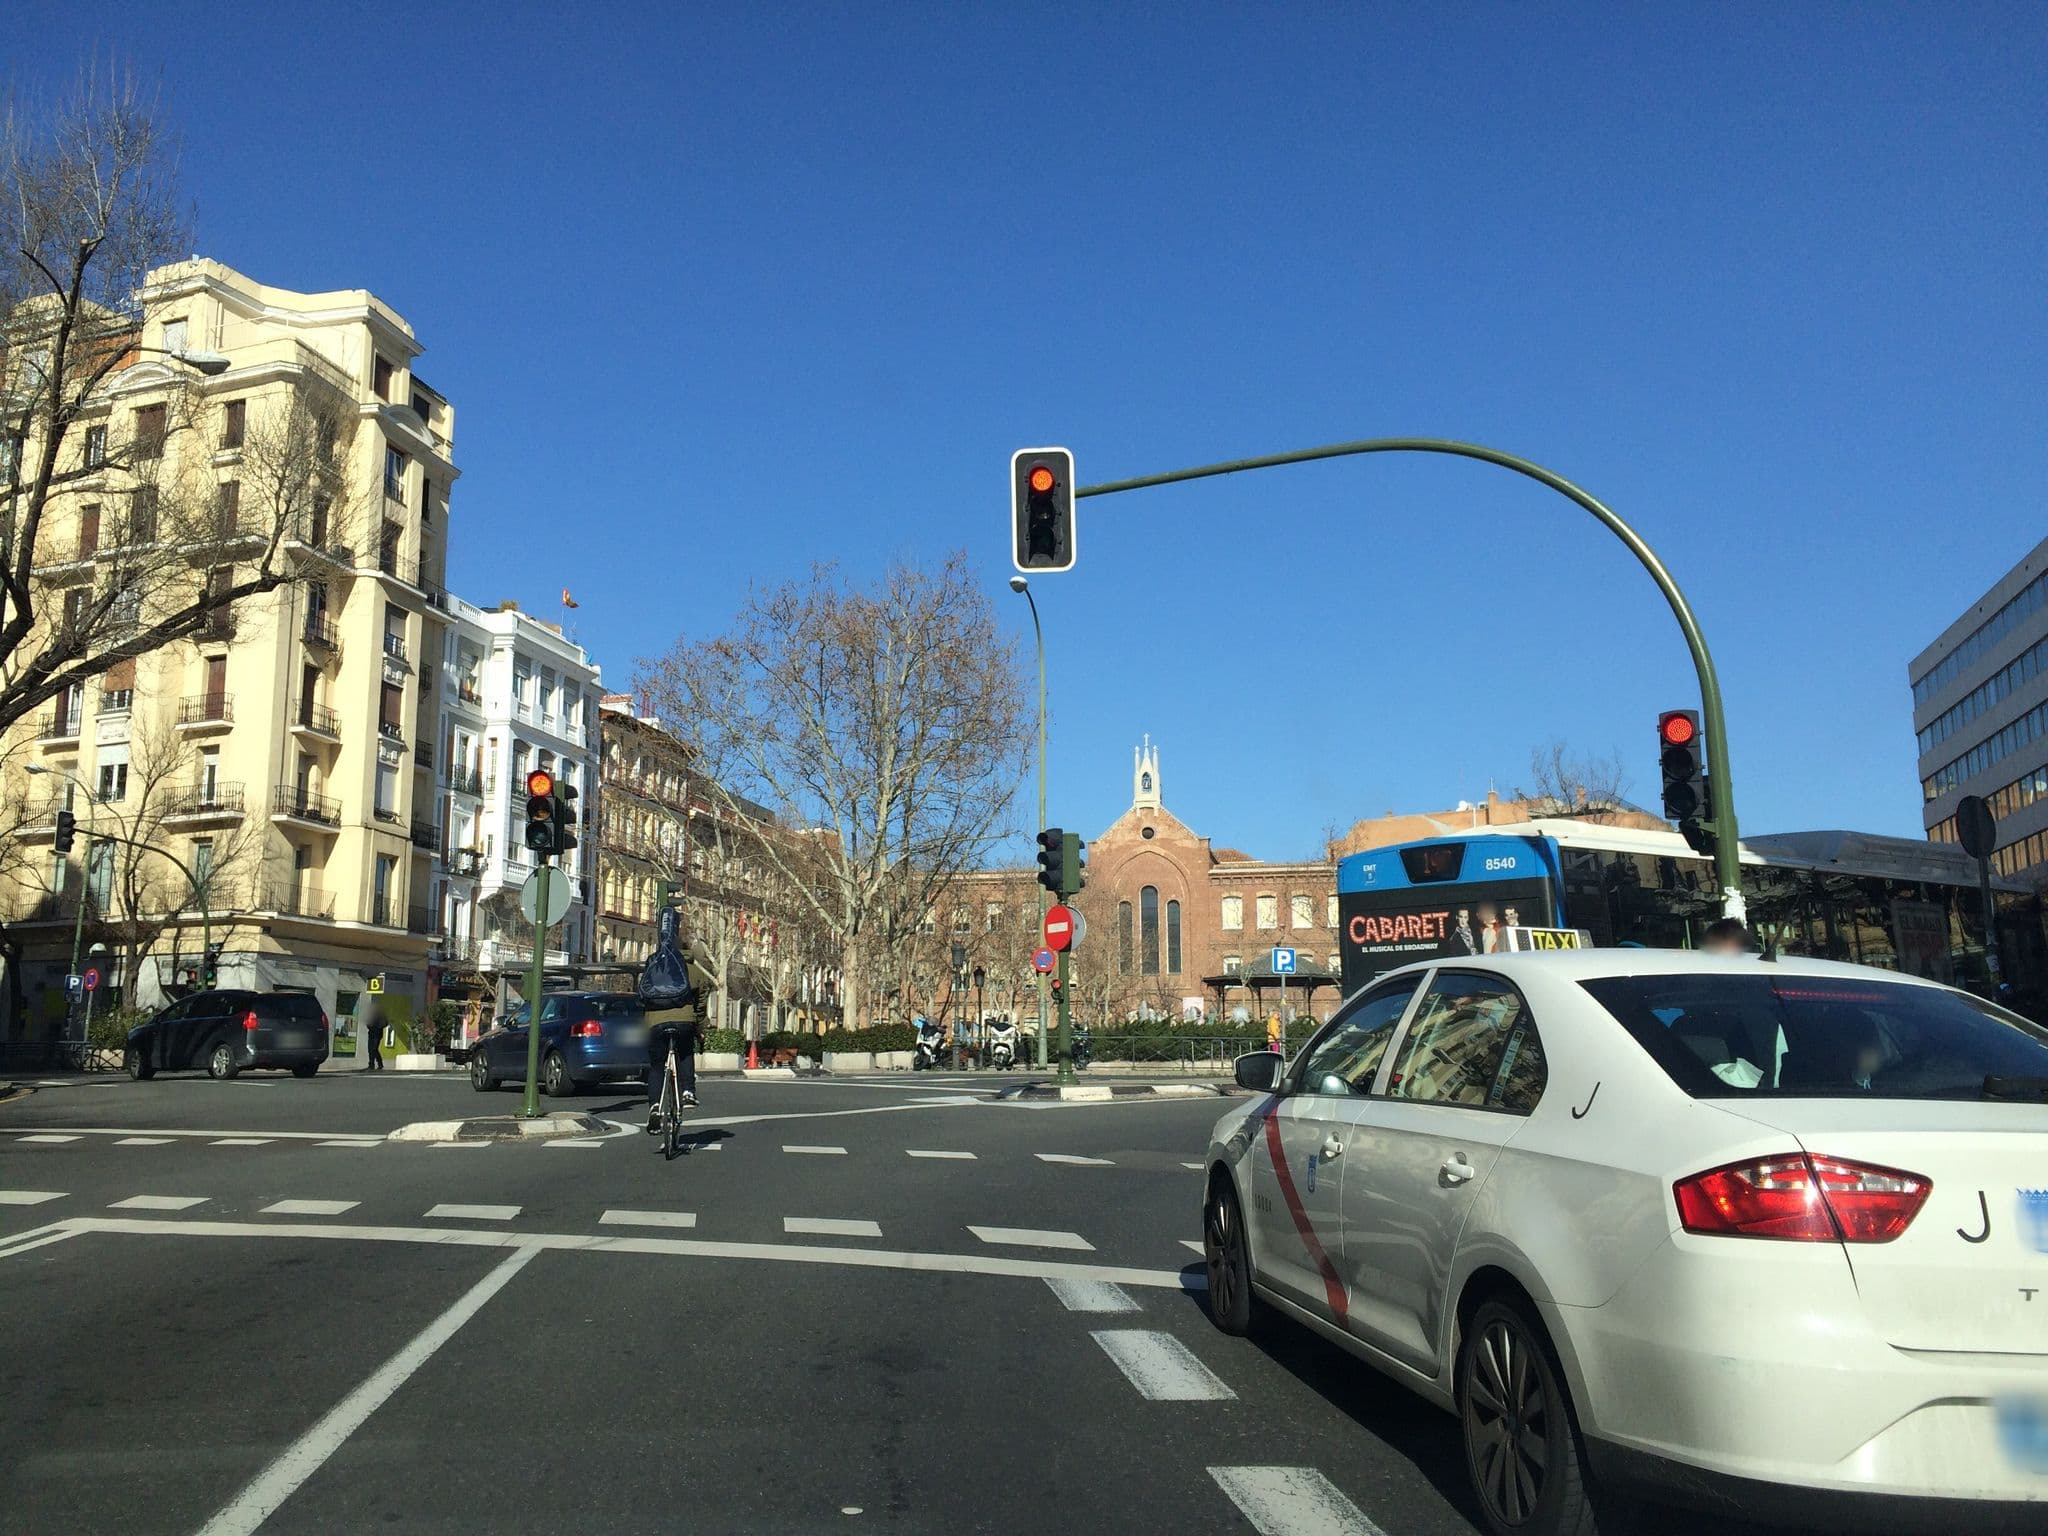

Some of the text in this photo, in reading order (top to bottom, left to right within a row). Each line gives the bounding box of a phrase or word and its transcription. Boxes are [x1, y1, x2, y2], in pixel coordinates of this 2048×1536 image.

[1485, 857, 1516, 870] 8540
[1349, 911, 1450, 944] CABARET
[1369, 945, 1395, 953] MUSICAL
[1404, 943, 1439, 951] BROADWAY
[1532, 931, 1578, 950] TAXI
[1277, 951, 1292, 971] P
[69, 977, 80, 989] P
[1572, 1081, 1600, 1119] J
[1956, 1190, 1991, 1243] J
